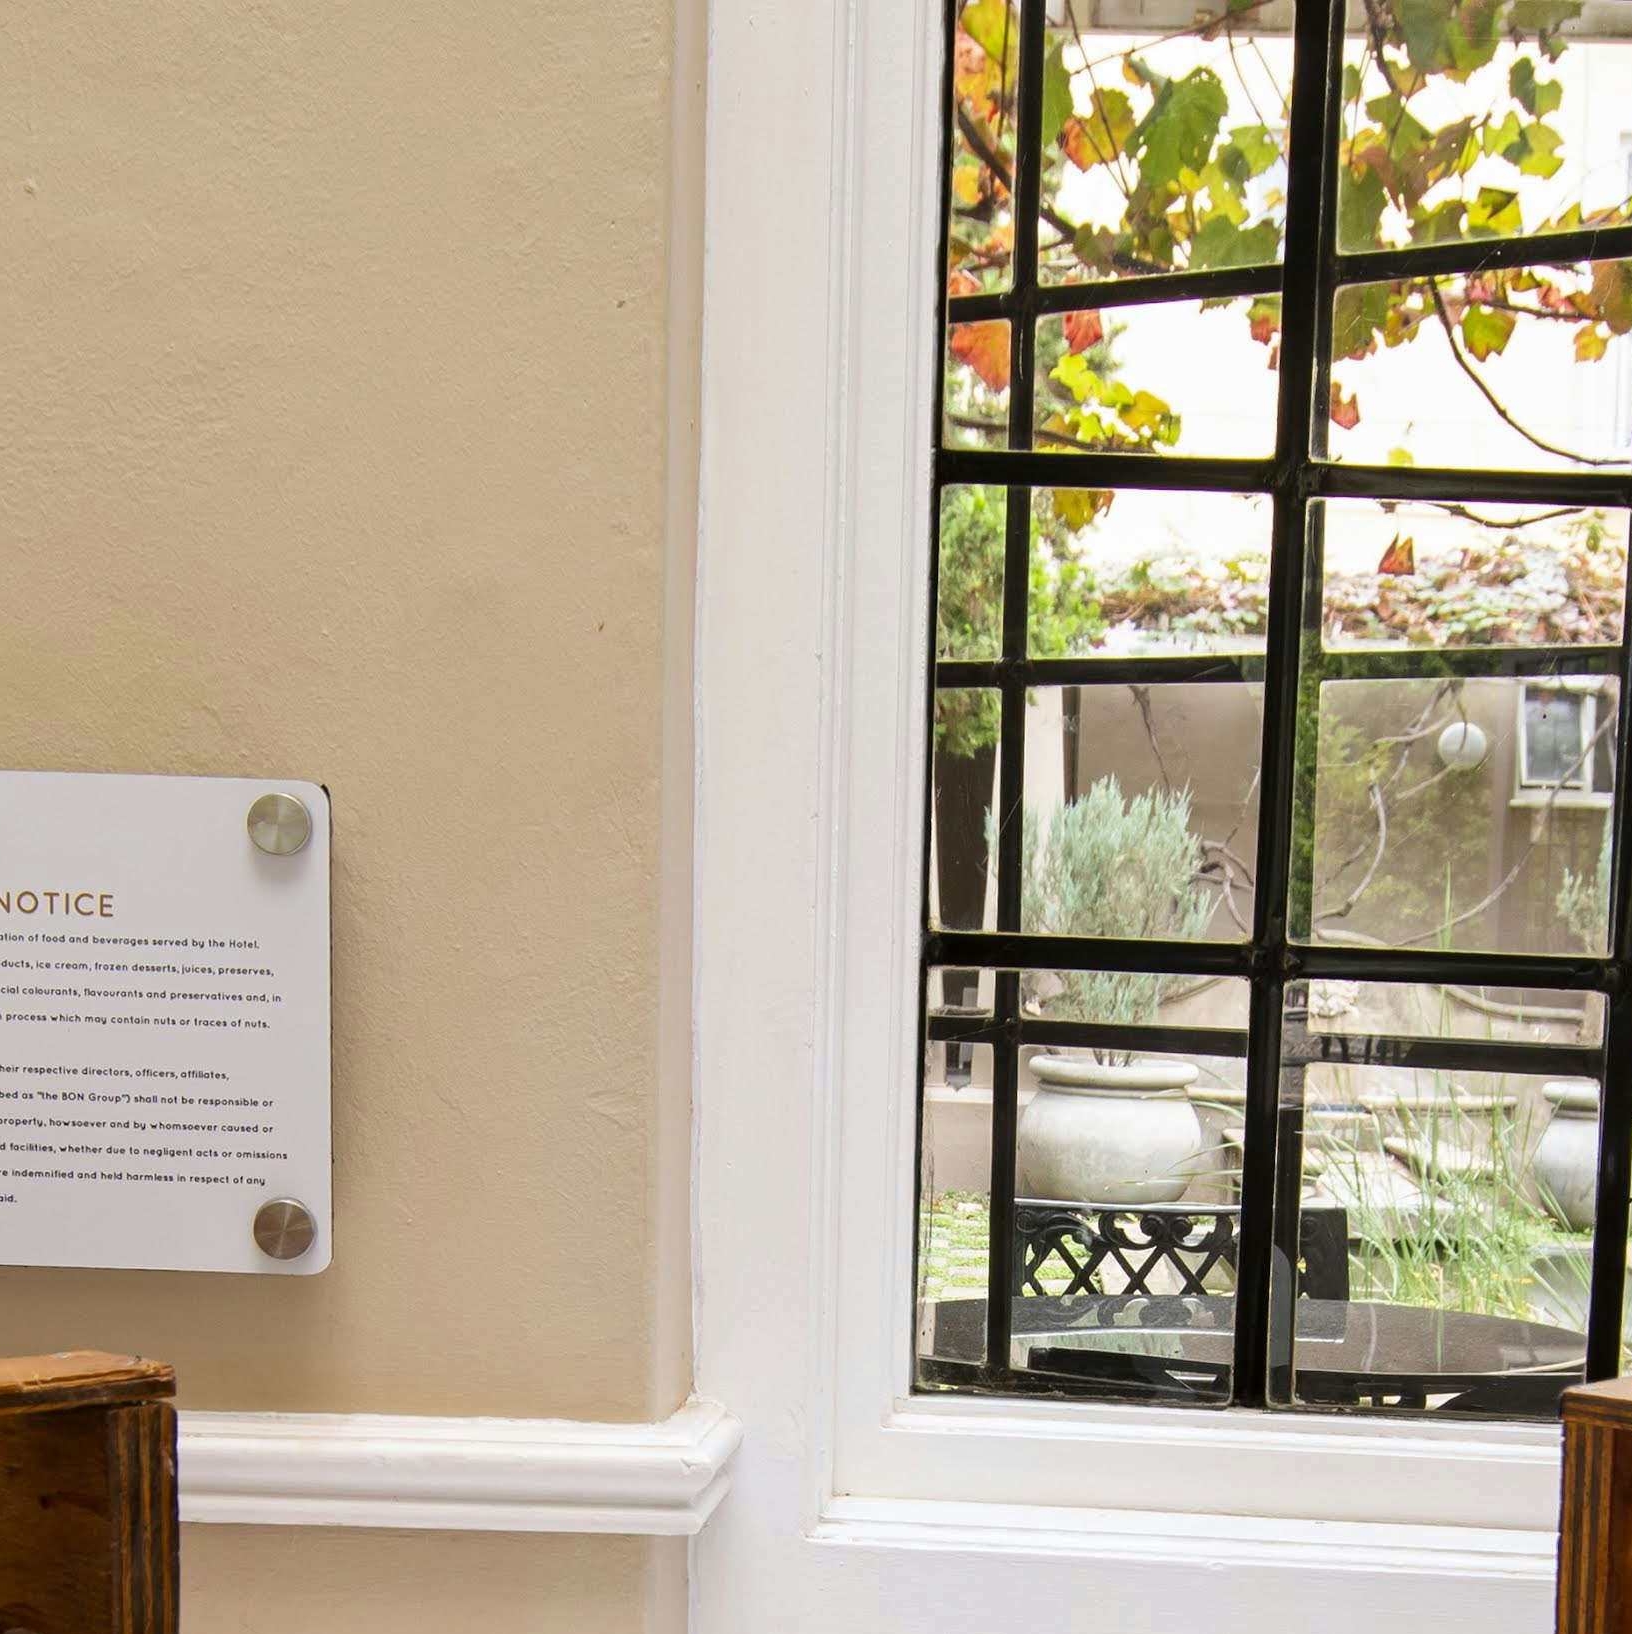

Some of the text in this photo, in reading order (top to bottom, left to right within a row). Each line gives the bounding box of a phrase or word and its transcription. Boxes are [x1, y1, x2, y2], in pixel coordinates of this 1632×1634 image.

[26, 932, 38, 943] of
[40, 932, 65, 943] food
[67, 934, 88, 944] and
[91, 934, 149, 948] beverages
[151, 936, 188, 947] served
[190, 937, 204, 949] by
[207, 938, 225, 948] the
[227, 938, 259, 949] Hotel.
[34, 959, 51, 969] ice
[53, 961, 91, 972] cream,
[93, 960, 128, 972] frozen
[130, 962, 179, 974] desserts,
[180, 963, 215, 976] juices,
[216, 966, 274, 977] preserves,
[20, 985, 81, 998] colourants,
[82, 986, 143, 998] flavourants
[144, 989, 166, 1000] and
[169, 991, 243, 1002] preservatives
[244, 992, 269, 1004] and,
[271, 993, 281, 1003] in
[4, 1012, 47, 1022] process
[48, 1012, 81, 1023] which
[83, 1014, 107, 1026] may
[109, 1014, 150, 1025] contain
[152, 1015, 176, 1026] nuts
[178, 1017, 190, 1026] or
[192, 1016, 227, 1028] traces
[229, 1017, 241, 1028] of
[243, 1018, 270, 1029] nuts.
[21, 1064, 78, 1076] respective
[80, 1065, 133, 1078] directors,
[134, 1067, 178, 1080] officers,
[179, 1068, 229, 1081] affiliates,
[20, 1091, 33, 1100] as
[60, 1090, 84, 1102] BON
[132, 1094, 157, 1104] shall
[159, 1094, 177, 1105] not
[180, 1094, 194, 1105] be
[197, 1096, 258, 1107] responsible
[261, 1099, 273, 1108] or
